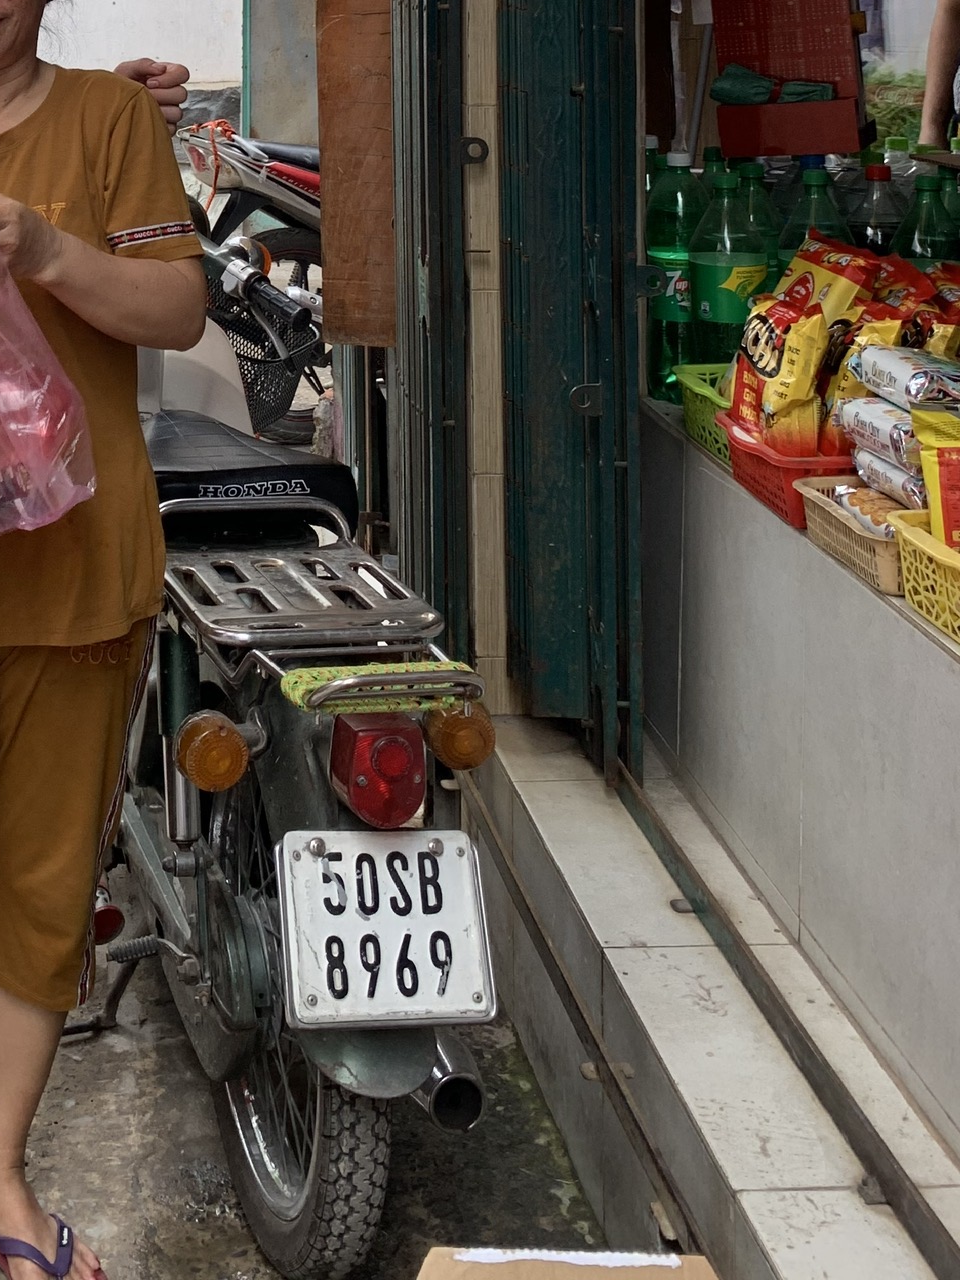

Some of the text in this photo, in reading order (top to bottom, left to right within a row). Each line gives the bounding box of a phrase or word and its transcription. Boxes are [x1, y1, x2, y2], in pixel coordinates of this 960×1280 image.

[665, 271, 688, 297] 7up
[199, 480, 310, 499] HONDA
[321, 851, 444, 917] 50SB
[324, 930, 453, 1001] 8969
